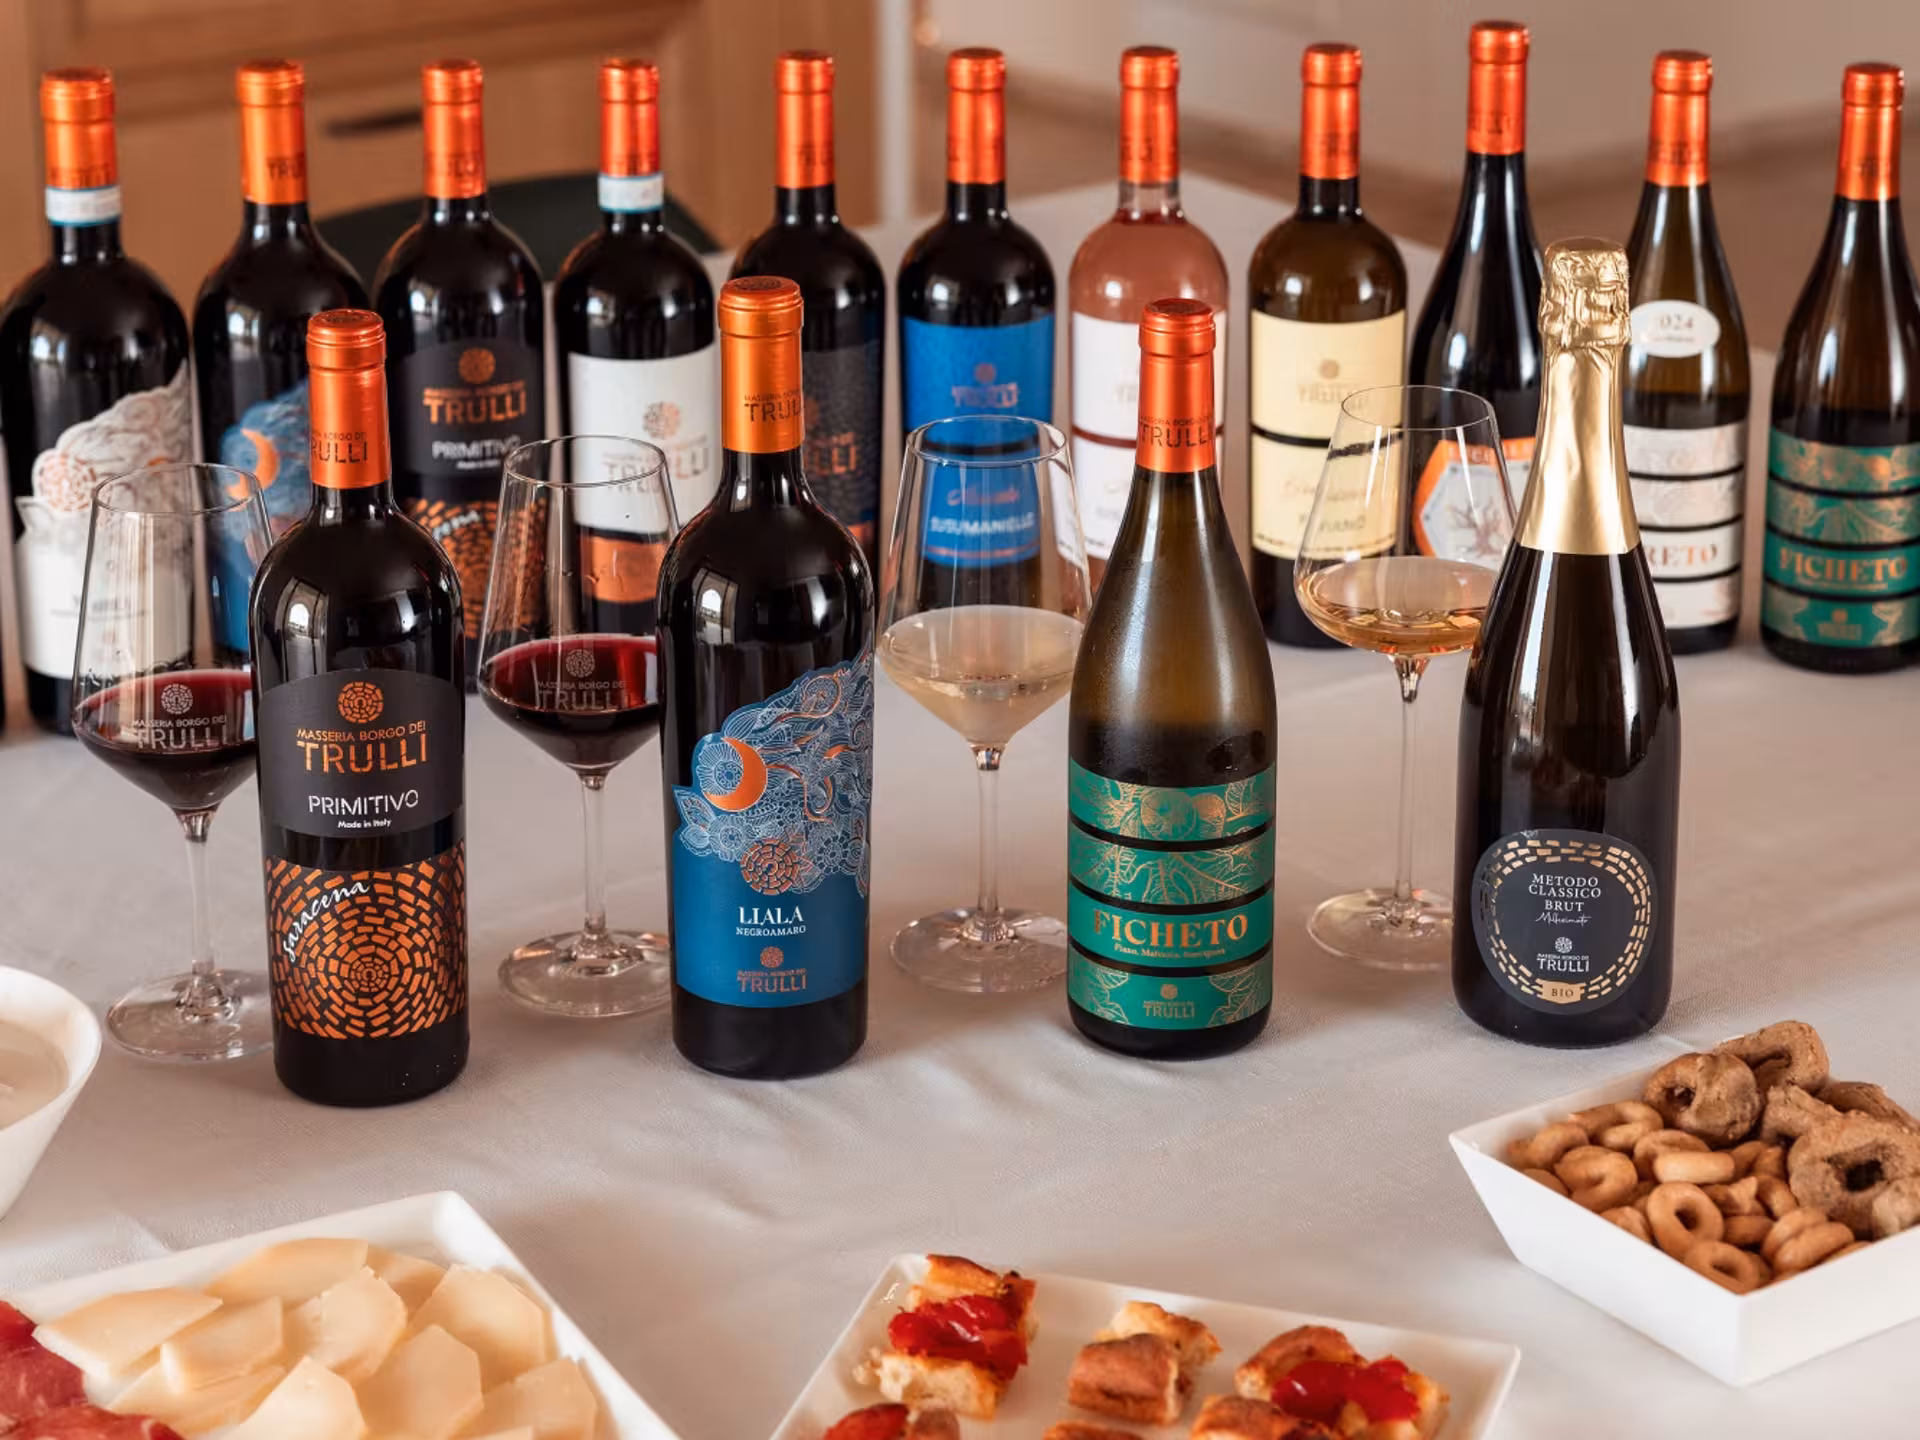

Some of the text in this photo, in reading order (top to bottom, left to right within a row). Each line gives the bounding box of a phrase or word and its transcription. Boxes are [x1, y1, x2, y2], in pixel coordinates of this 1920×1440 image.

[423, 391, 526, 423] TRULLI
[176, 717, 210, 728] BORGO
[297, 720, 426, 742] MASSERIA BORGO DEI
[133, 725, 227, 749] TRULLI
[297, 733, 427, 773] TRULLI
[308, 789, 419, 815] PRIMITIVO
[338, 818, 391, 828] Made in Italy
[1532, 873, 1598, 886] METODO
[1528, 884, 1601, 898] CLASSICO
[1544, 899, 1584, 912] BRUT
[738, 906, 804, 926] LIALA
[736, 925, 806, 936] NEGROAMARO
[1093, 908, 1248, 948] FICHETO
[1536, 957, 1590, 972] TRULLI
[737, 974, 806, 993] TRULLI
[1551, 988, 1574, 997] BIO
